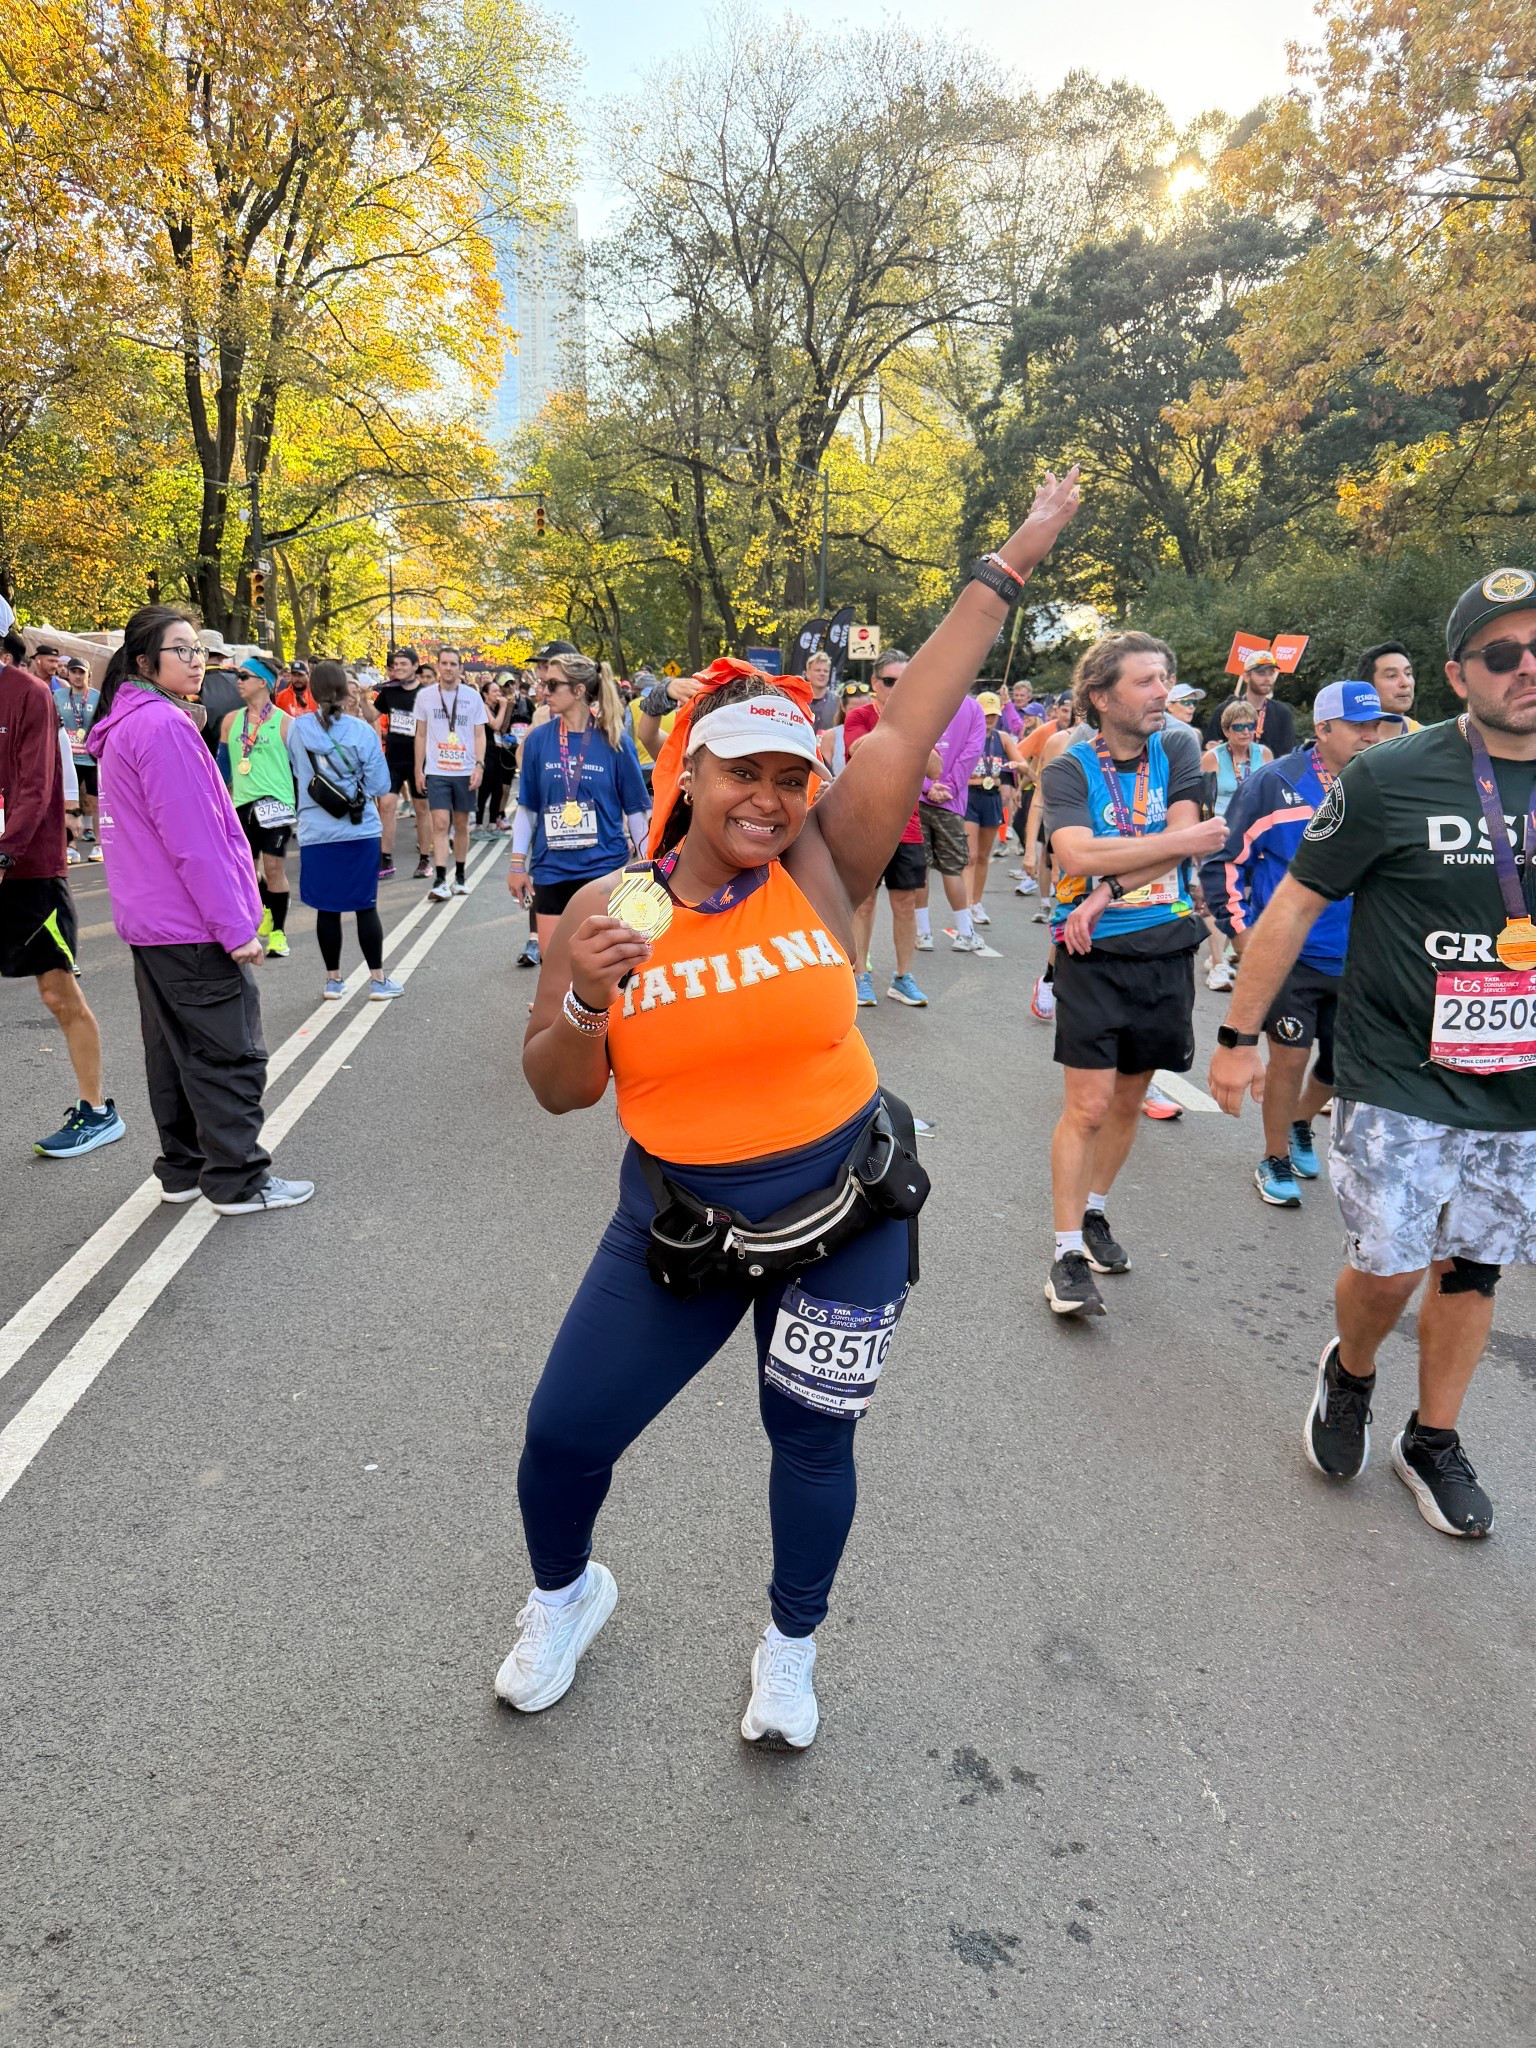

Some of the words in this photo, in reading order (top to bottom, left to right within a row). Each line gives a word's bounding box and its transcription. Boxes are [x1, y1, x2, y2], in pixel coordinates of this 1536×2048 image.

[750, 704, 776, 717] best
[440, 750, 465, 760] 45354
[1426, 815, 1528, 852] DS
[1443, 854, 1526, 865] RUNNG
[1424, 930, 1502, 963] GR
[620, 929, 846, 1019] TATIANA
[1454, 976, 1481, 992] tcs
[797, 1298, 828, 1322] tcs
[831, 1314, 872, 1323] CONSULTANCY
[830, 1320, 857, 1328] SERVICES
[784, 1322, 894, 1370] 68516
[810, 1364, 866, 1382] TATIANA
[794, 1385, 810, 1396] BLUE
[811, 1393, 838, 1405] CORRAL
[838, 1398, 846, 1406] F
